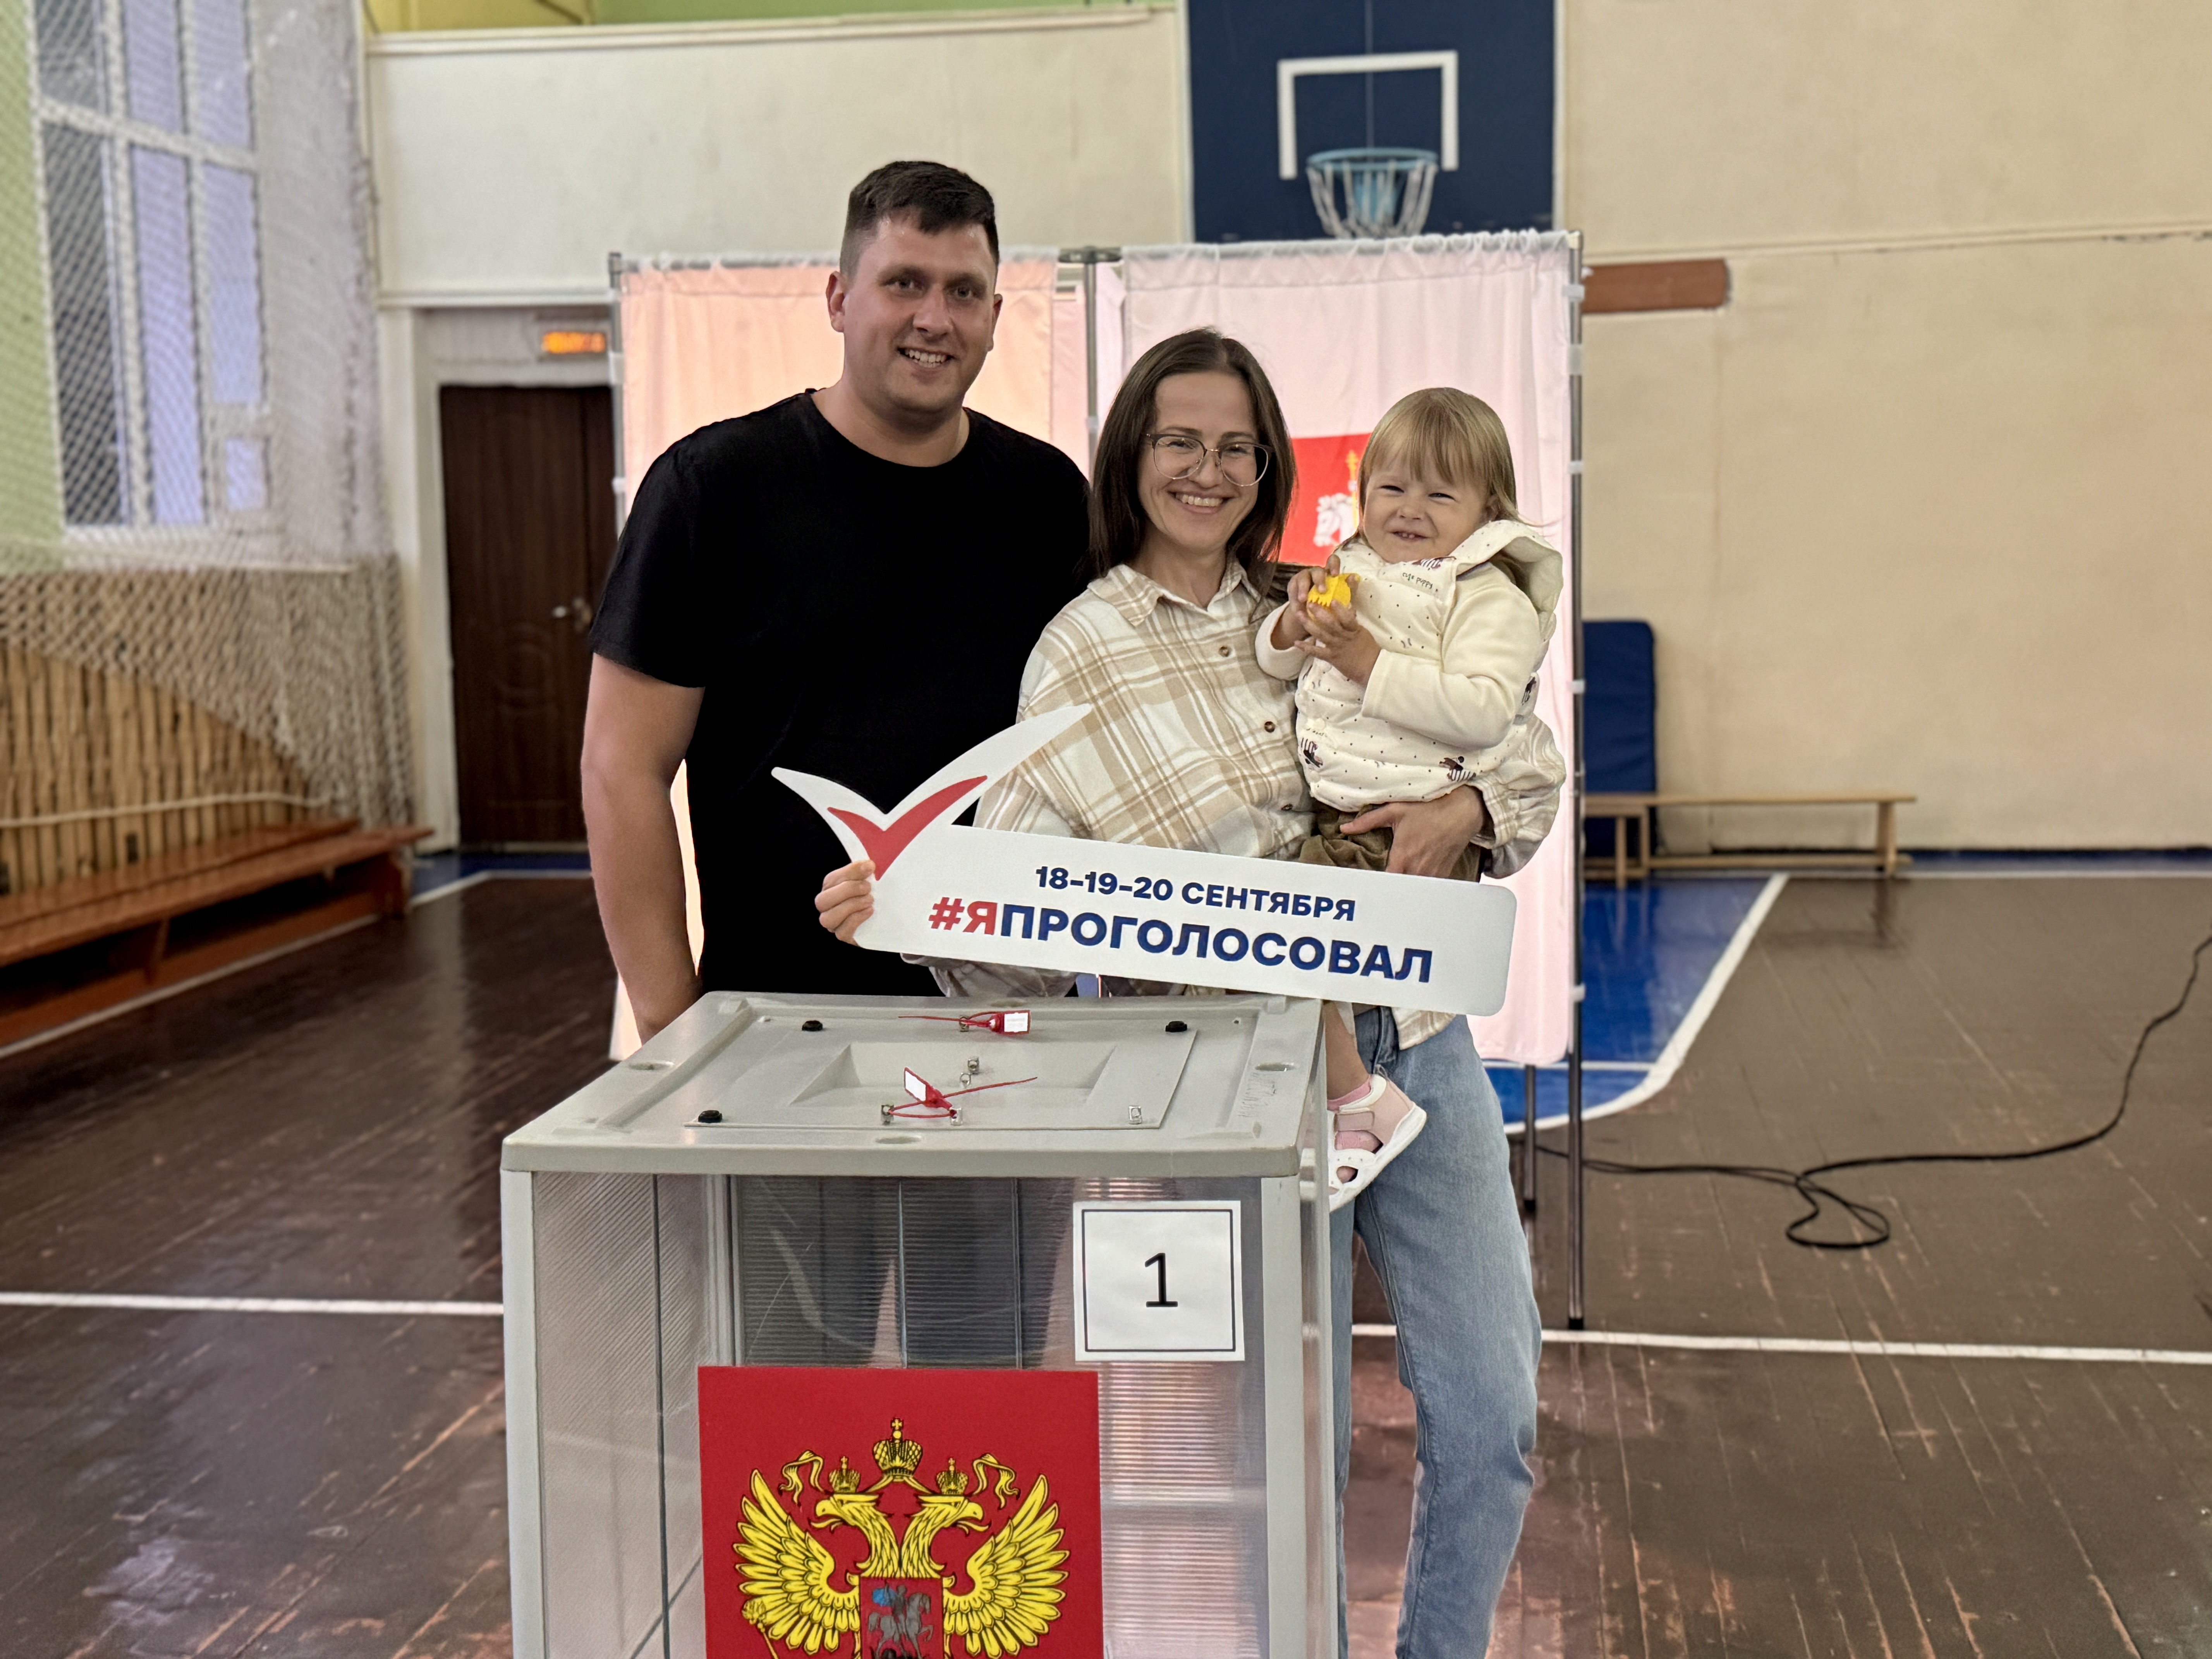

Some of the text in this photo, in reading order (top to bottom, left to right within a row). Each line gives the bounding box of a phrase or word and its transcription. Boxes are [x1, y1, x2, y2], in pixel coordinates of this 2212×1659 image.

[1036, 866, 1355, 921] 18-19-20 СЕНТЯБРЯ
[928, 896, 1433, 983] #ЯПРОГОЛОСОВАЛ
[1144, 1252, 1178, 1308] 1
